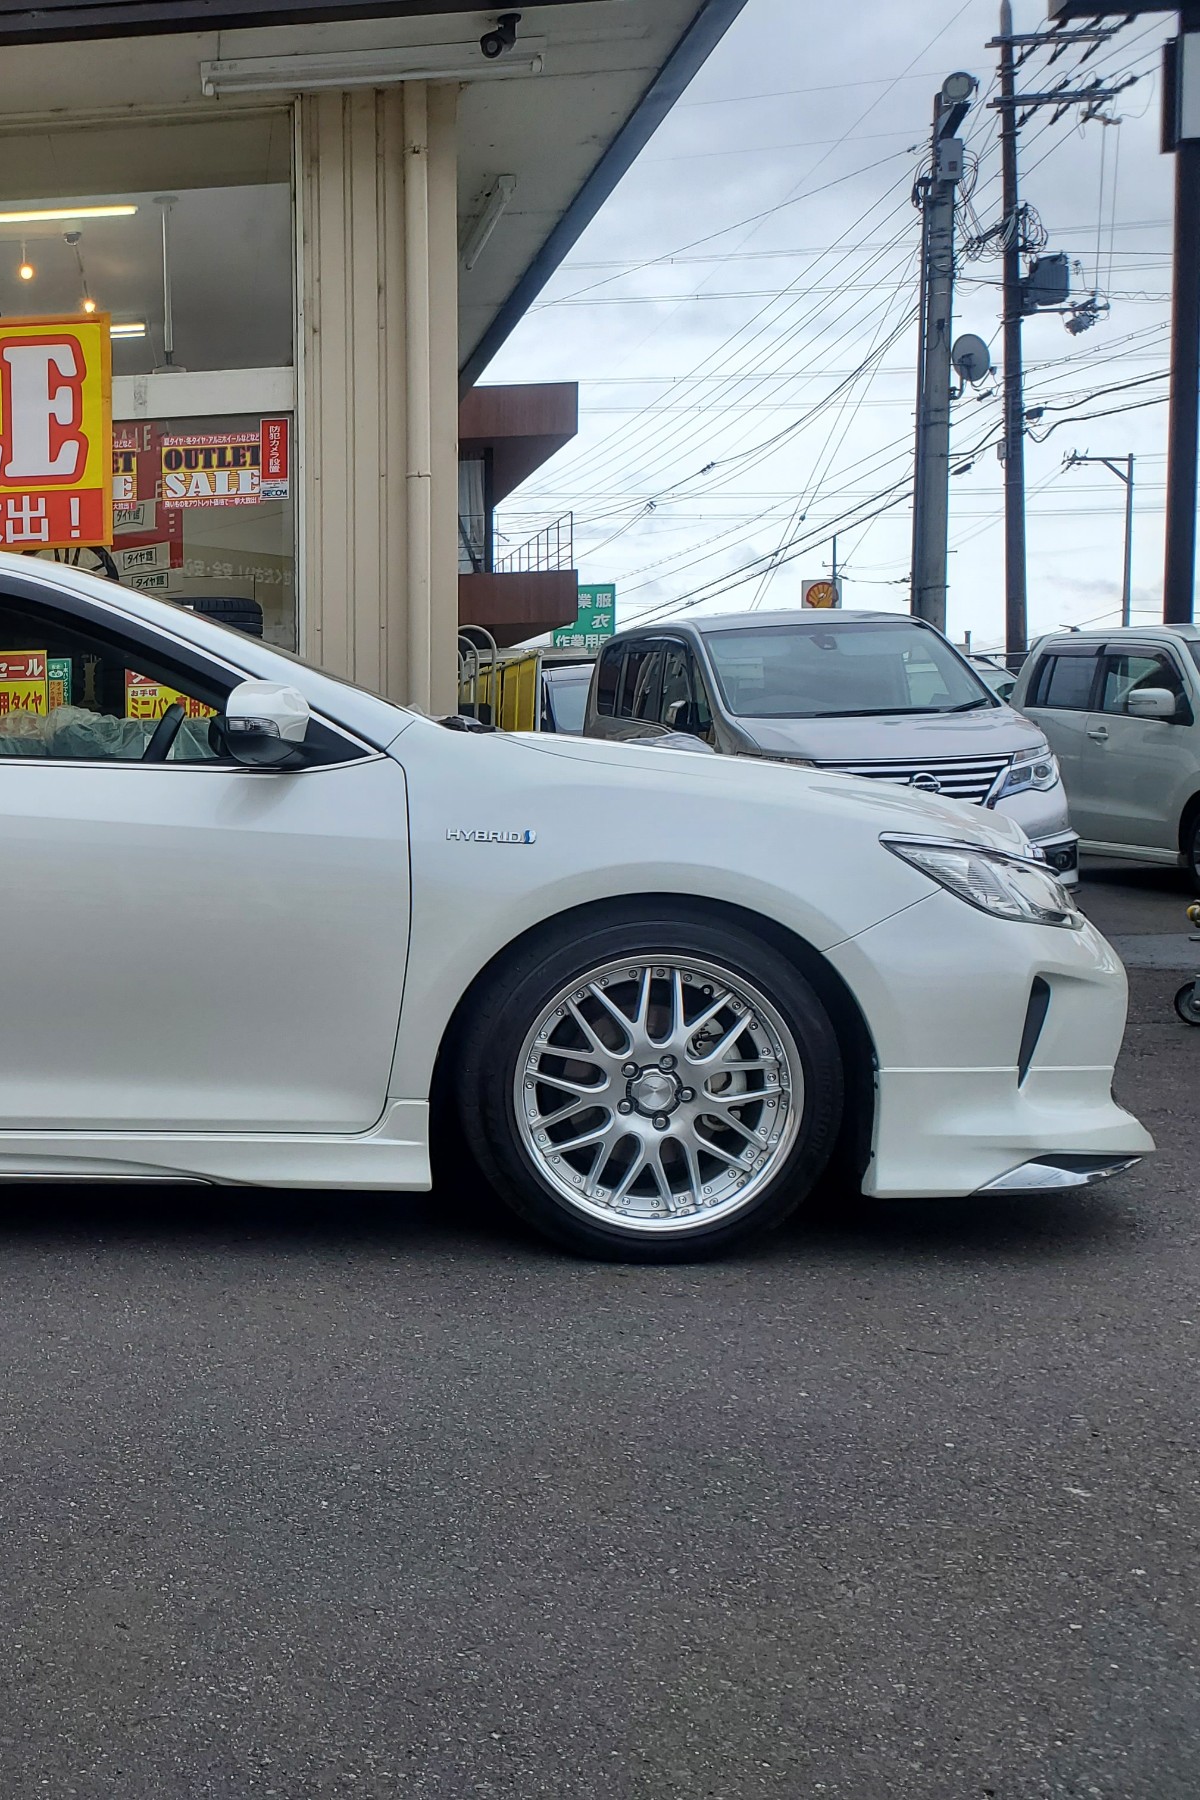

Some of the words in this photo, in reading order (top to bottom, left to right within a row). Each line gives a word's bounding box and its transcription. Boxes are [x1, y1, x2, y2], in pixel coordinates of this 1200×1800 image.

[268, 425, 281, 473] 防犯カメラ設置
[164, 445, 260, 472] OUTLET
[165, 469, 260, 499] SALE
[261, 489, 288, 497] SECOM
[127, 550, 153, 565] タイヤ館
[135, 575, 165, 588] タイヤ館
[130, 688, 158, 697] お手頃
[445, 827, 523, 843] HYBRID
